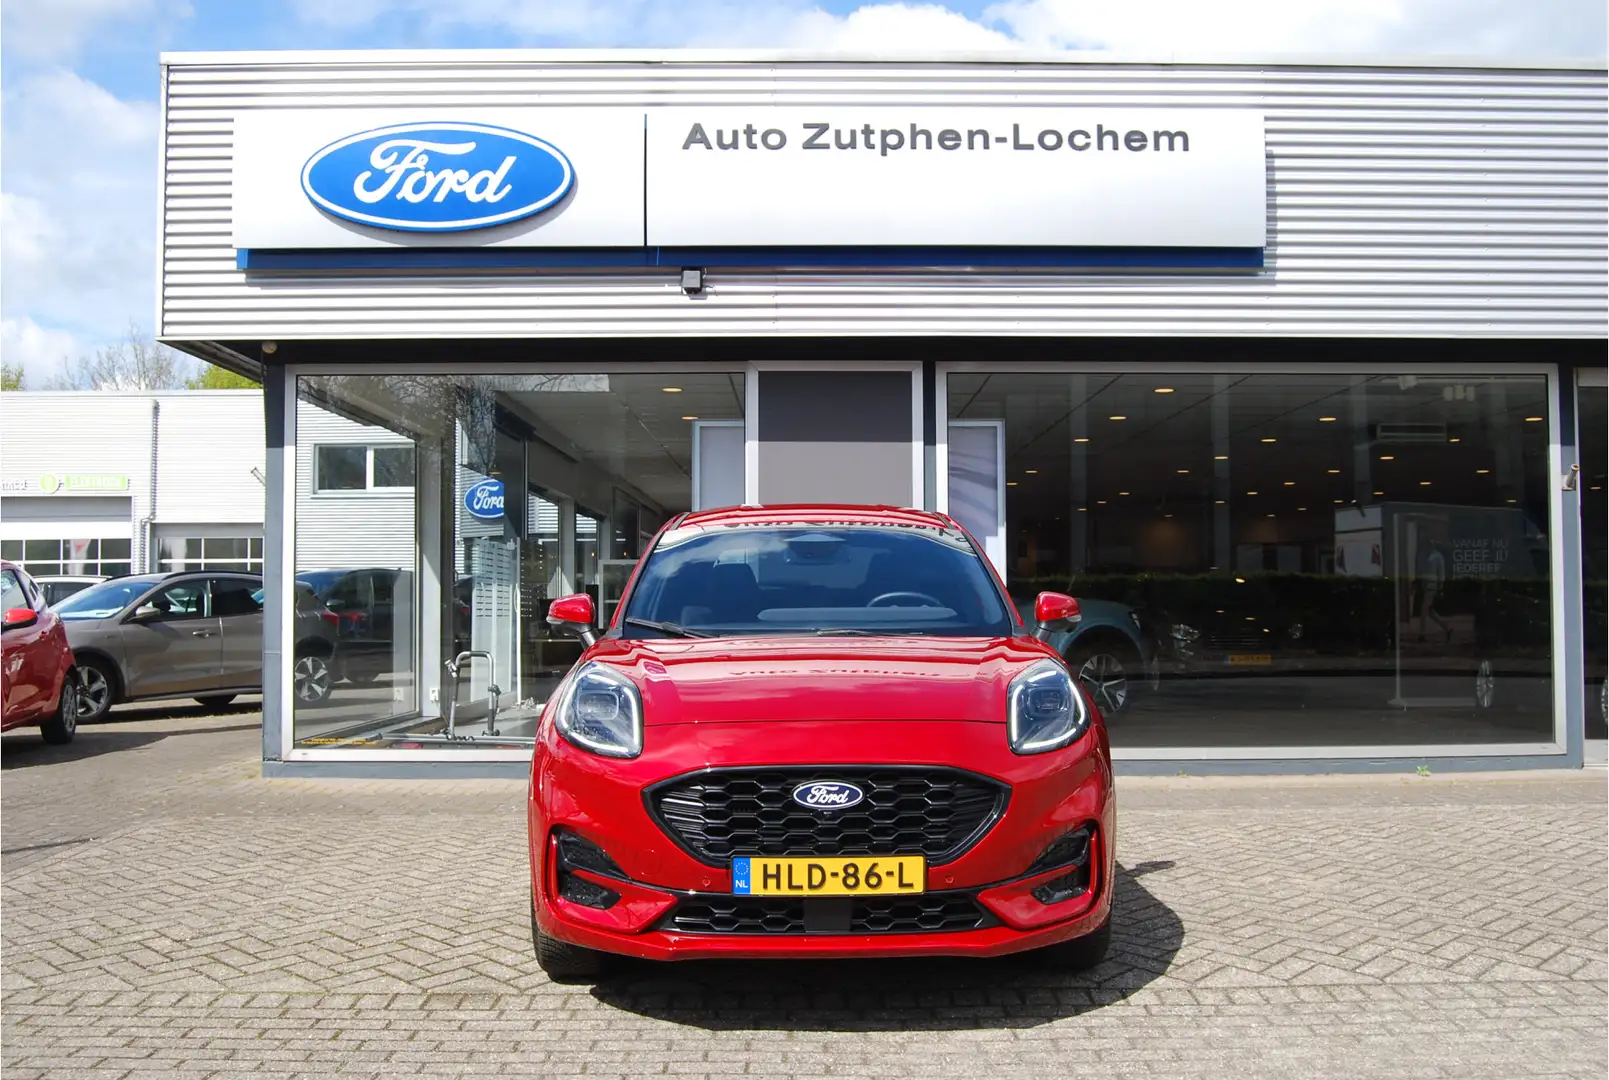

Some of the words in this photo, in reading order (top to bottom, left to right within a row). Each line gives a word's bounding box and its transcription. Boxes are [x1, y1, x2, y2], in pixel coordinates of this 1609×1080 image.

[682, 123, 788, 151] Auto
[801, 122, 1191, 157] Zutphen-Lochem
[353, 139, 516, 203] Ford
[1452, 549, 1490, 562] GEEF
[806, 785, 850, 804] Ford
[735, 880, 748, 889] NL
[762, 862, 914, 890] HLD-86-L
